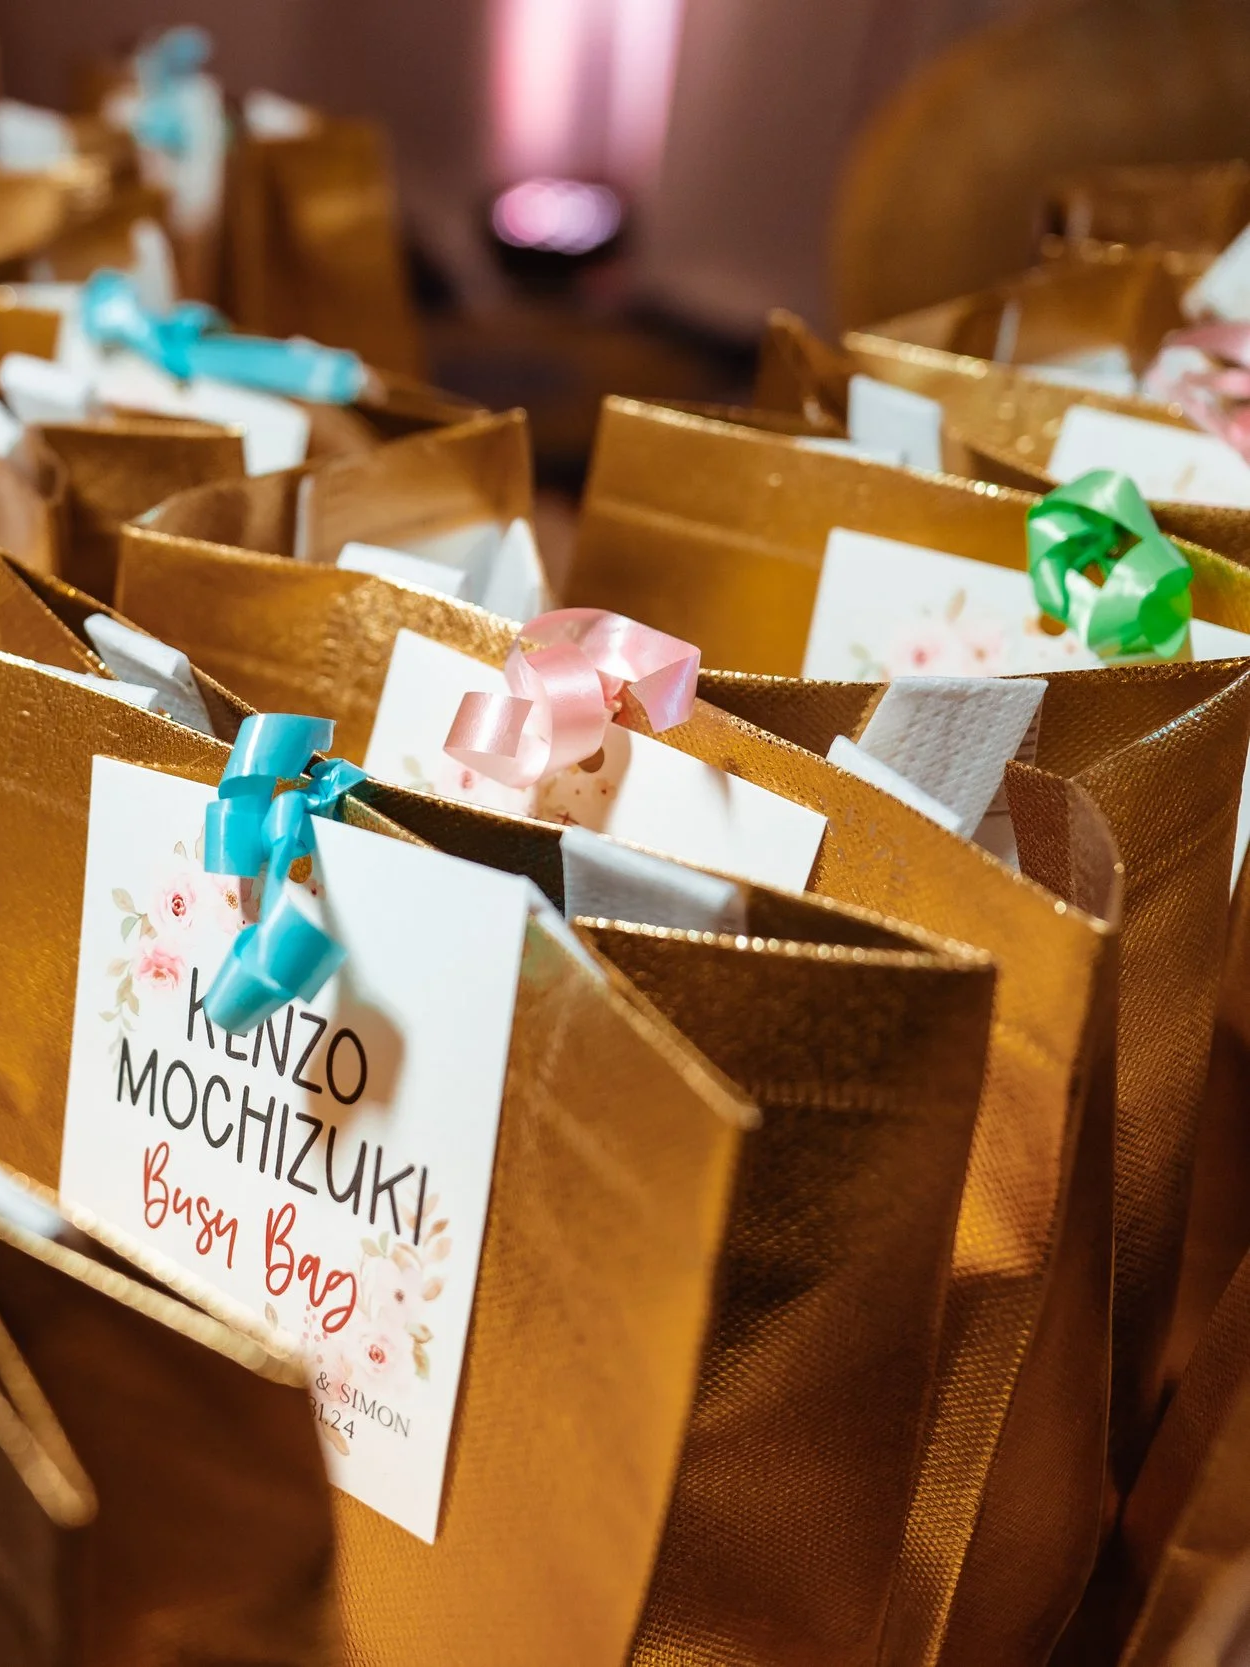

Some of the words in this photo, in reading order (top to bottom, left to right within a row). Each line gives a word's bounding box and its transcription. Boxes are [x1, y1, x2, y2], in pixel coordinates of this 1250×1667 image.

[116, 1037, 429, 1247] MOCHIZUKI
[143, 1140, 239, 1270] Busy
[264, 1202, 358, 1334] Bag
[315, 1371, 331, 1396] &
[339, 1382, 411, 1439] SIMON
